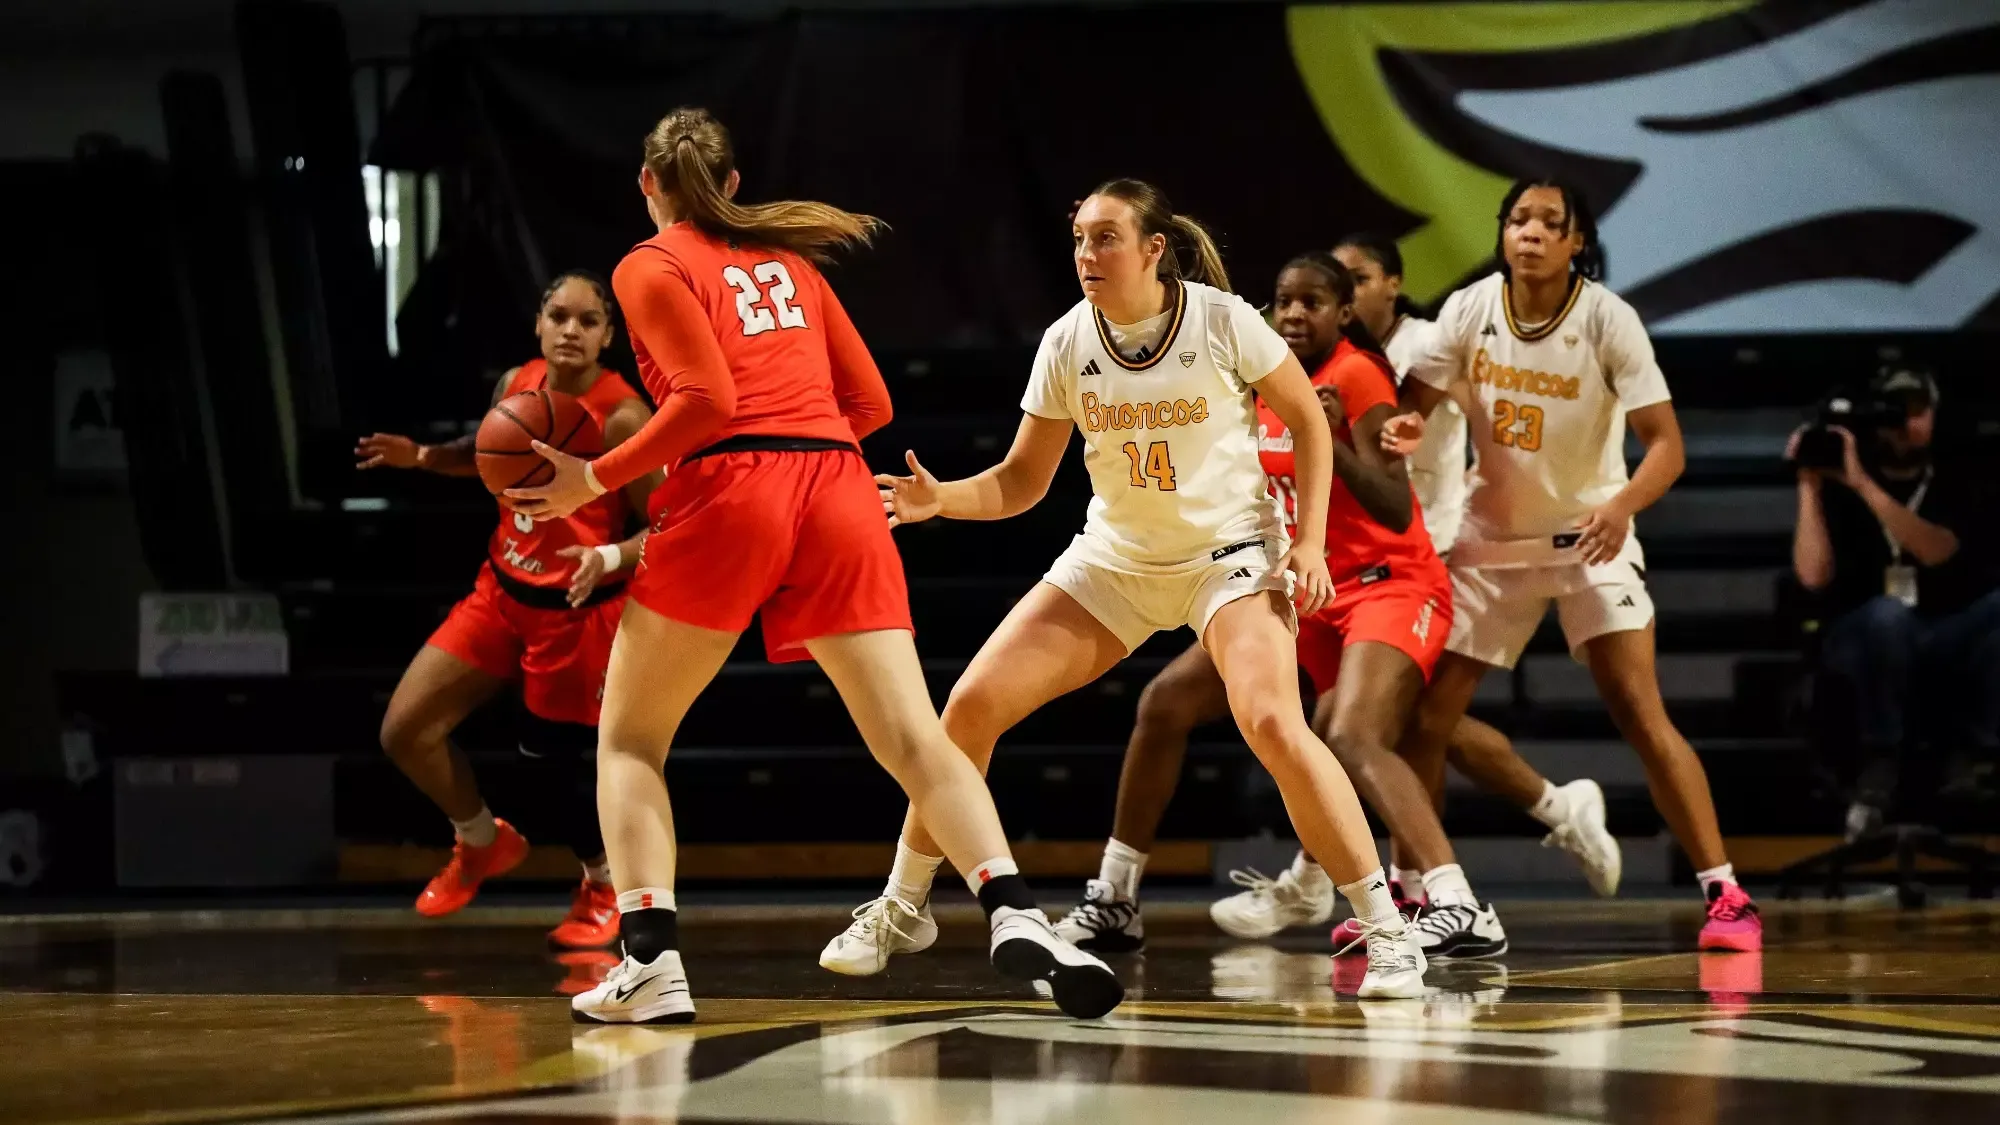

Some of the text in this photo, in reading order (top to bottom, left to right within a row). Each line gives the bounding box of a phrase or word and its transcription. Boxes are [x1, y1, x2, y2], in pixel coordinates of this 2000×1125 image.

[722, 260, 809, 336] 22
[1473, 348, 1580, 400] Broncos
[1082, 392, 1209, 432] Broncos
[1493, 399, 1544, 452] 23
[1123, 441, 1176, 491] 14
